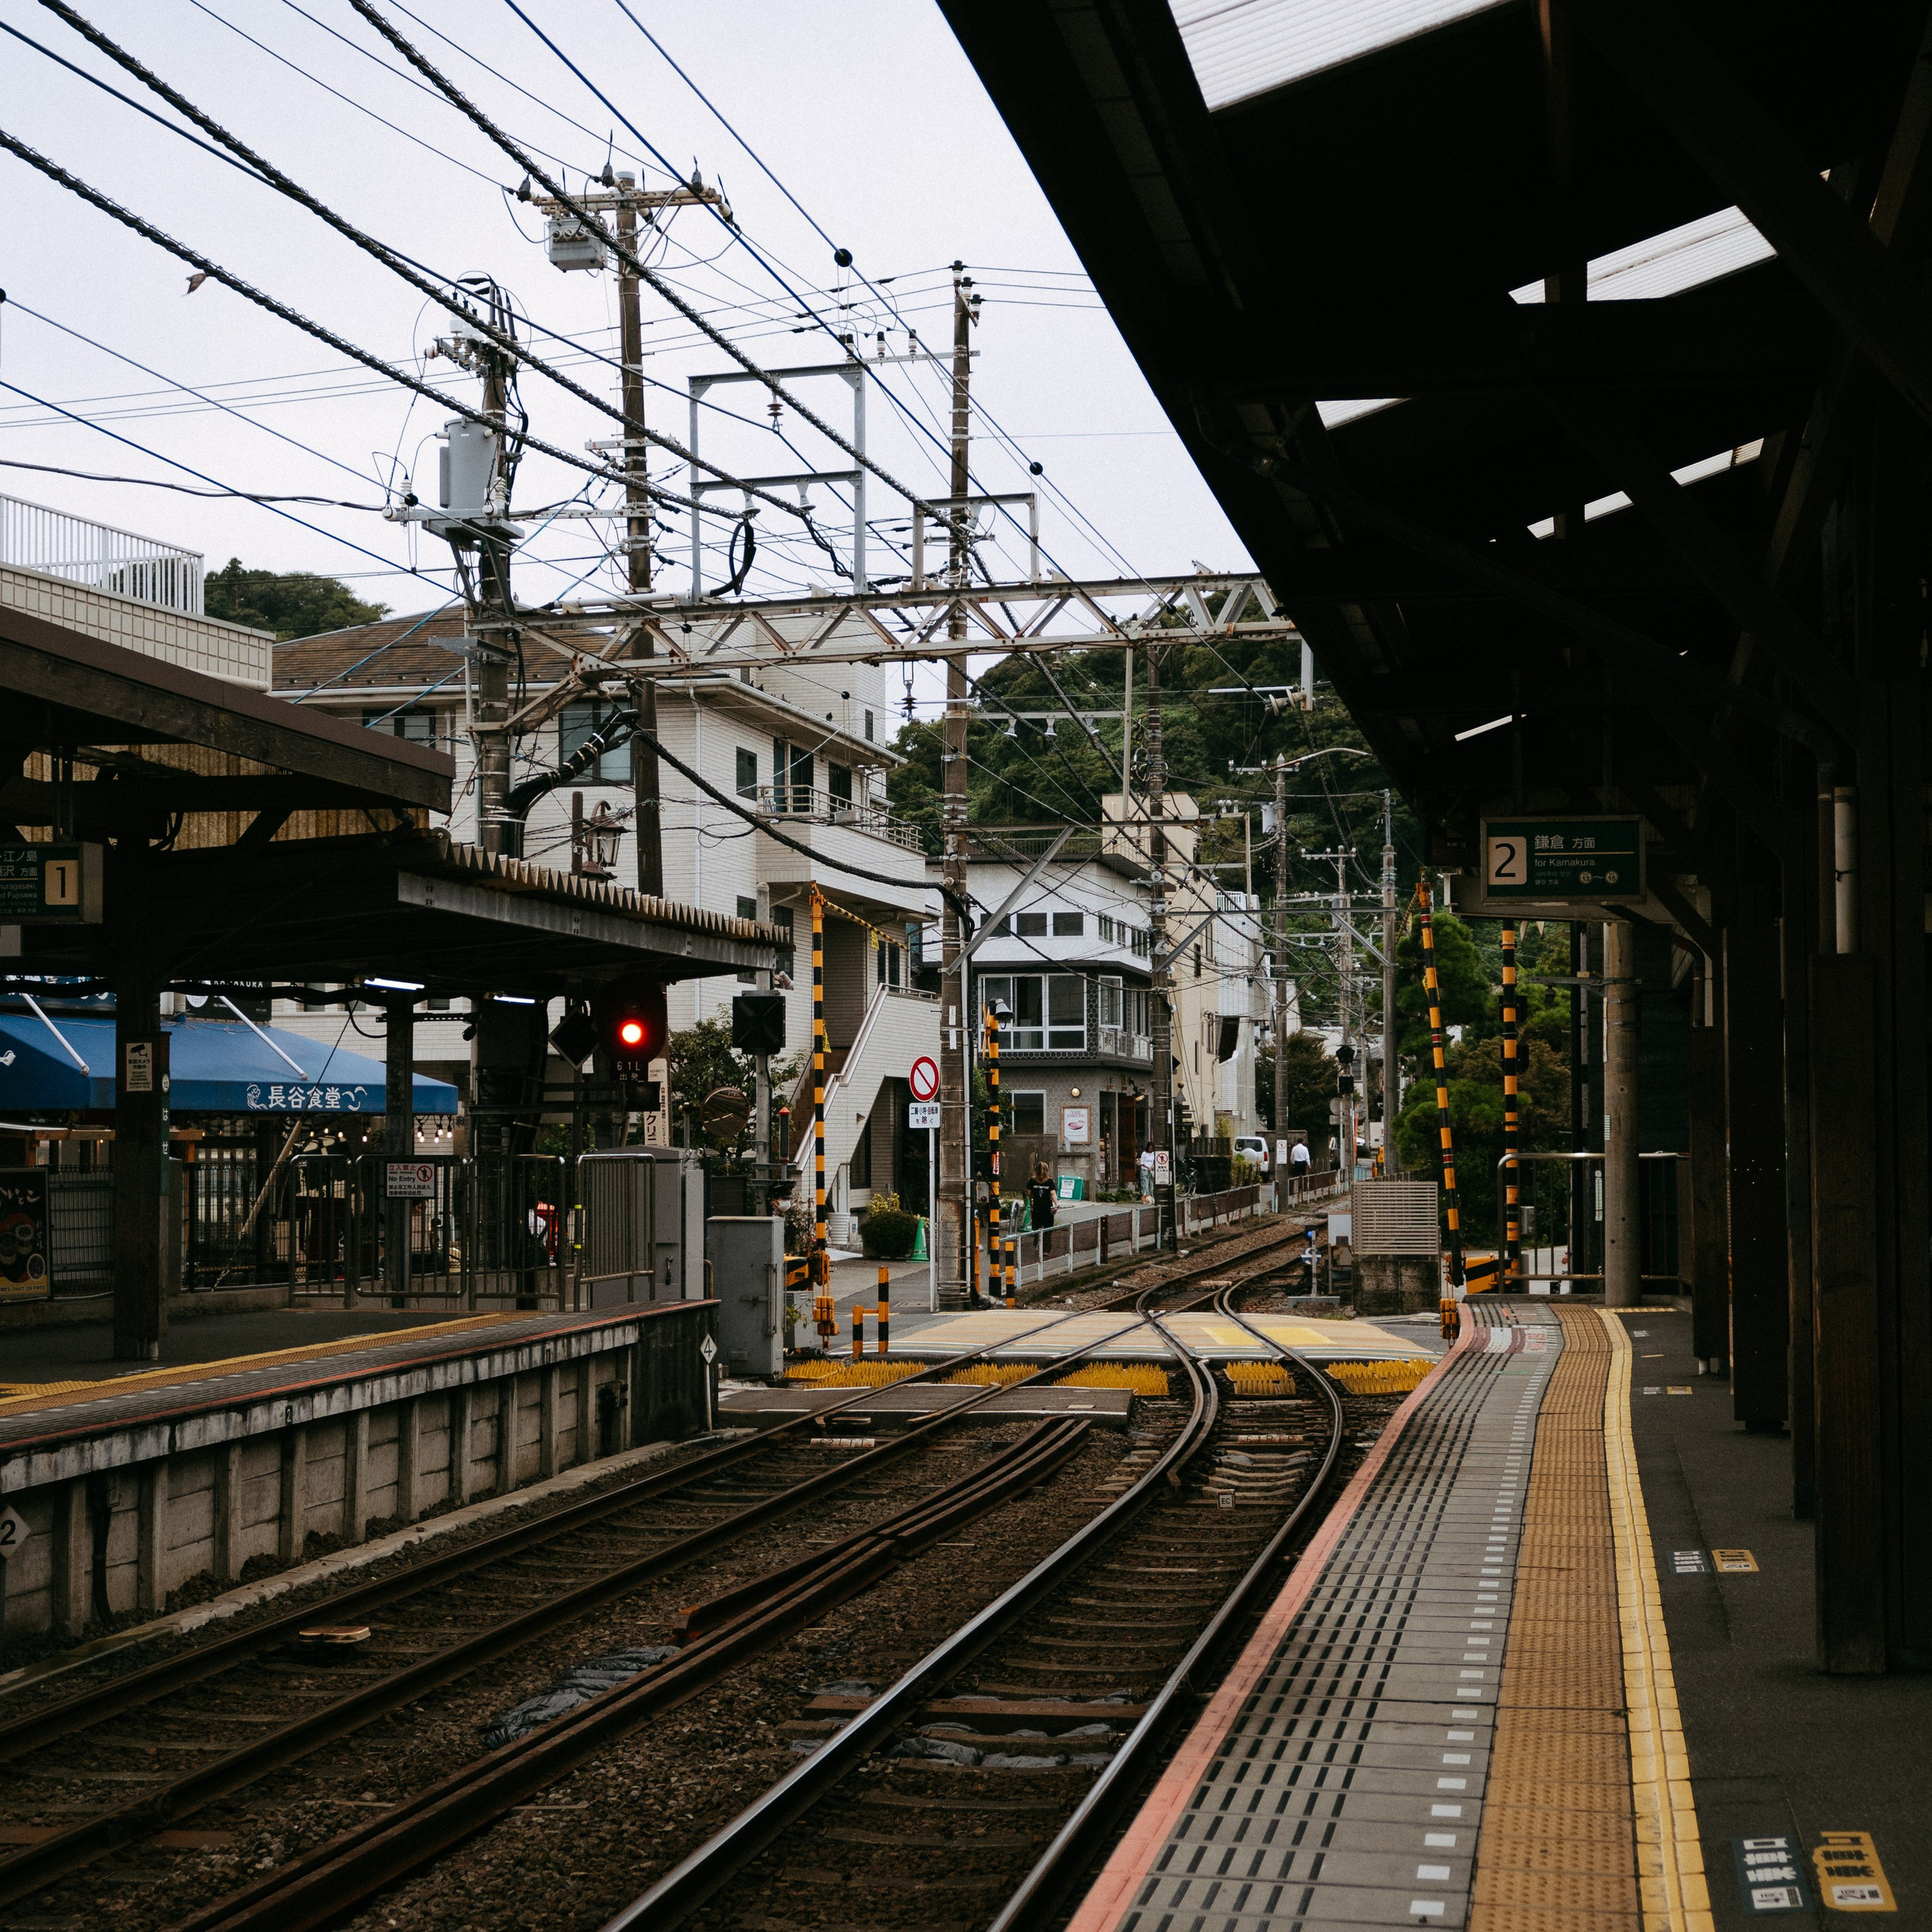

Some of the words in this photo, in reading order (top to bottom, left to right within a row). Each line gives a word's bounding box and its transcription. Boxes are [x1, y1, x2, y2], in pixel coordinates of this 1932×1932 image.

[1534, 835, 1564, 850] 鎌倉
[1572, 837, 1595, 848] 方面
[20, 867, 38, 876] 方面
[1495, 843, 1516, 877] 2
[1534, 859, 1547, 867] for
[1549, 858, 1595, 867] Kamakura
[56, 866, 66, 898] 1
[268, 1085, 340, 1109] 長谷食堂
[162, 1107, 168, 1155] はせ
[703, 1338, 712, 1357] 4
[0, 1519, 16, 1546] 2
